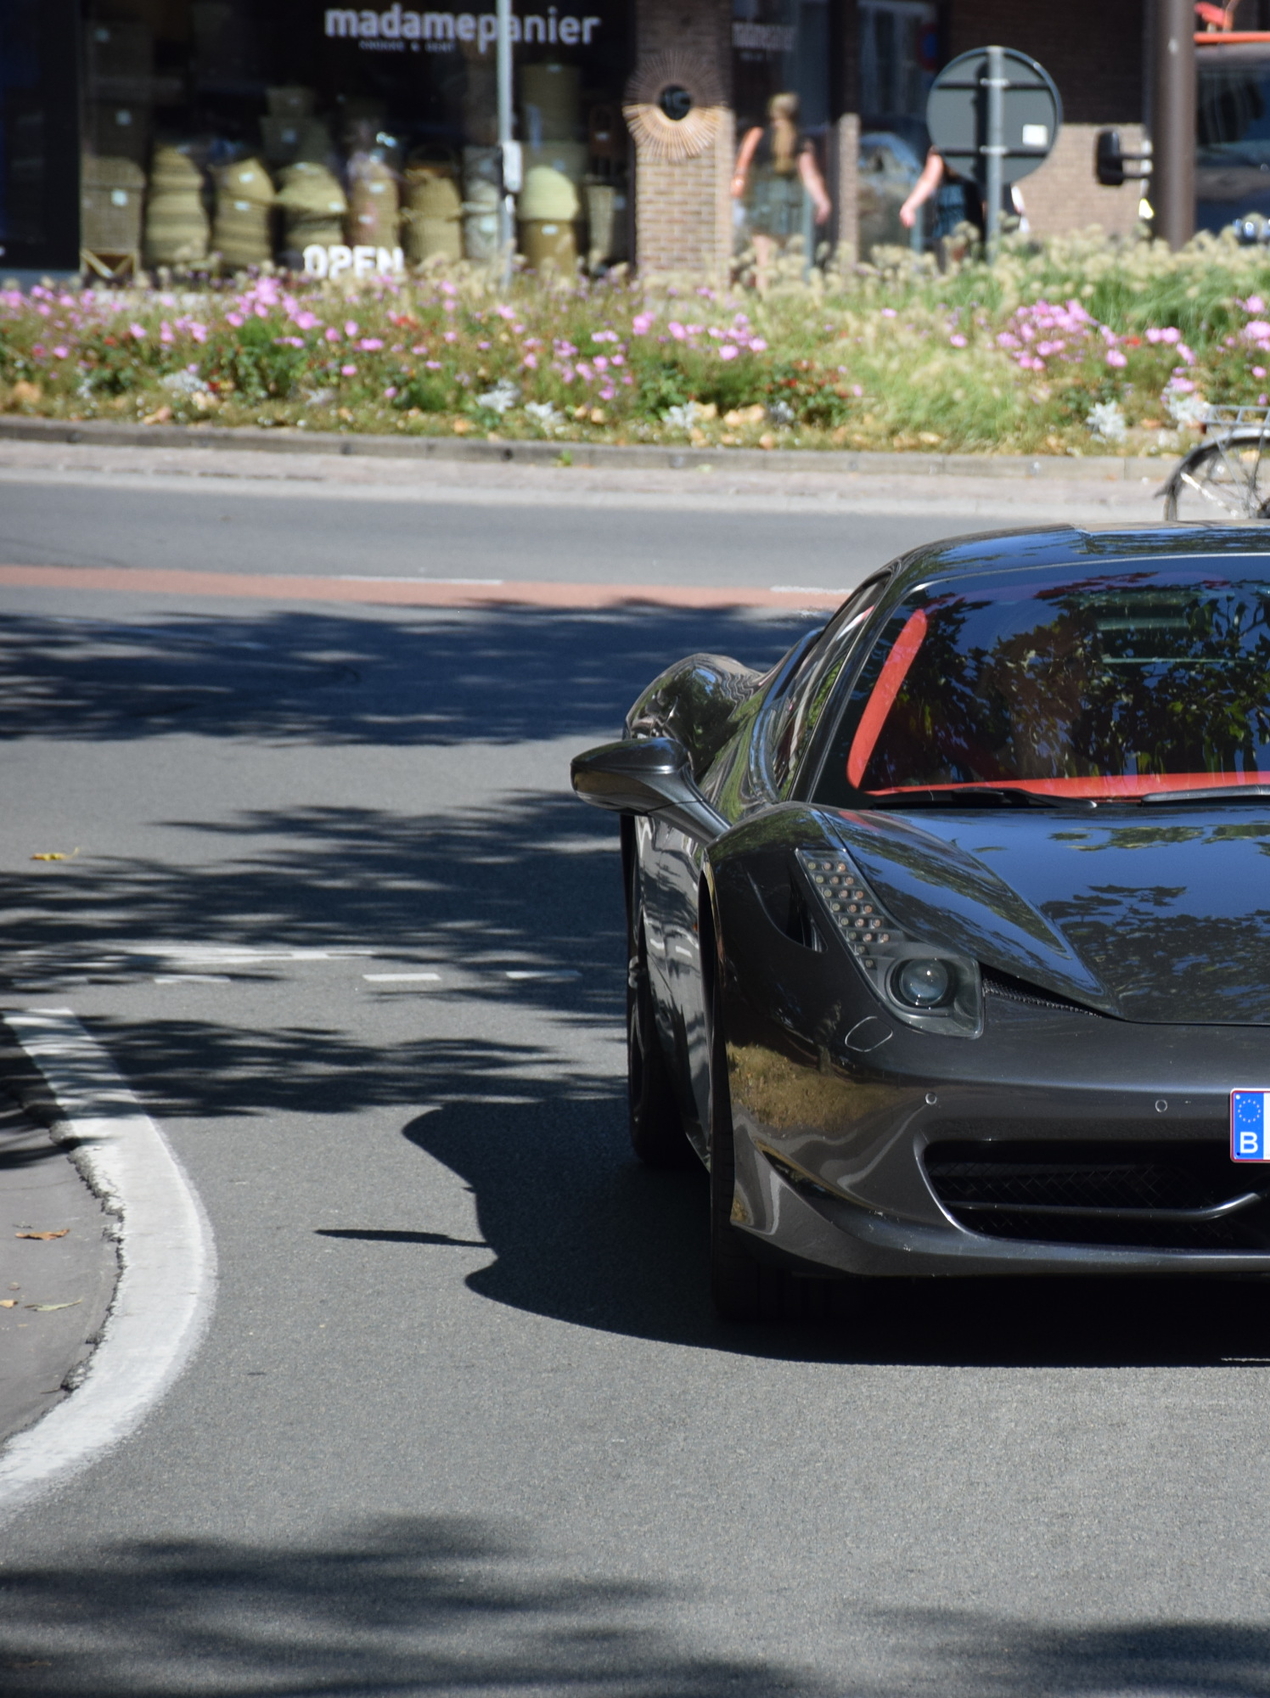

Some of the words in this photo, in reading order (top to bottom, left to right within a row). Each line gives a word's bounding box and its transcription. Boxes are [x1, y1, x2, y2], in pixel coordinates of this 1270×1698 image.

[325, 3, 600, 53] madamepanier
[303, 244, 404, 279] OPEN
[1240, 1131, 1259, 1154] B
